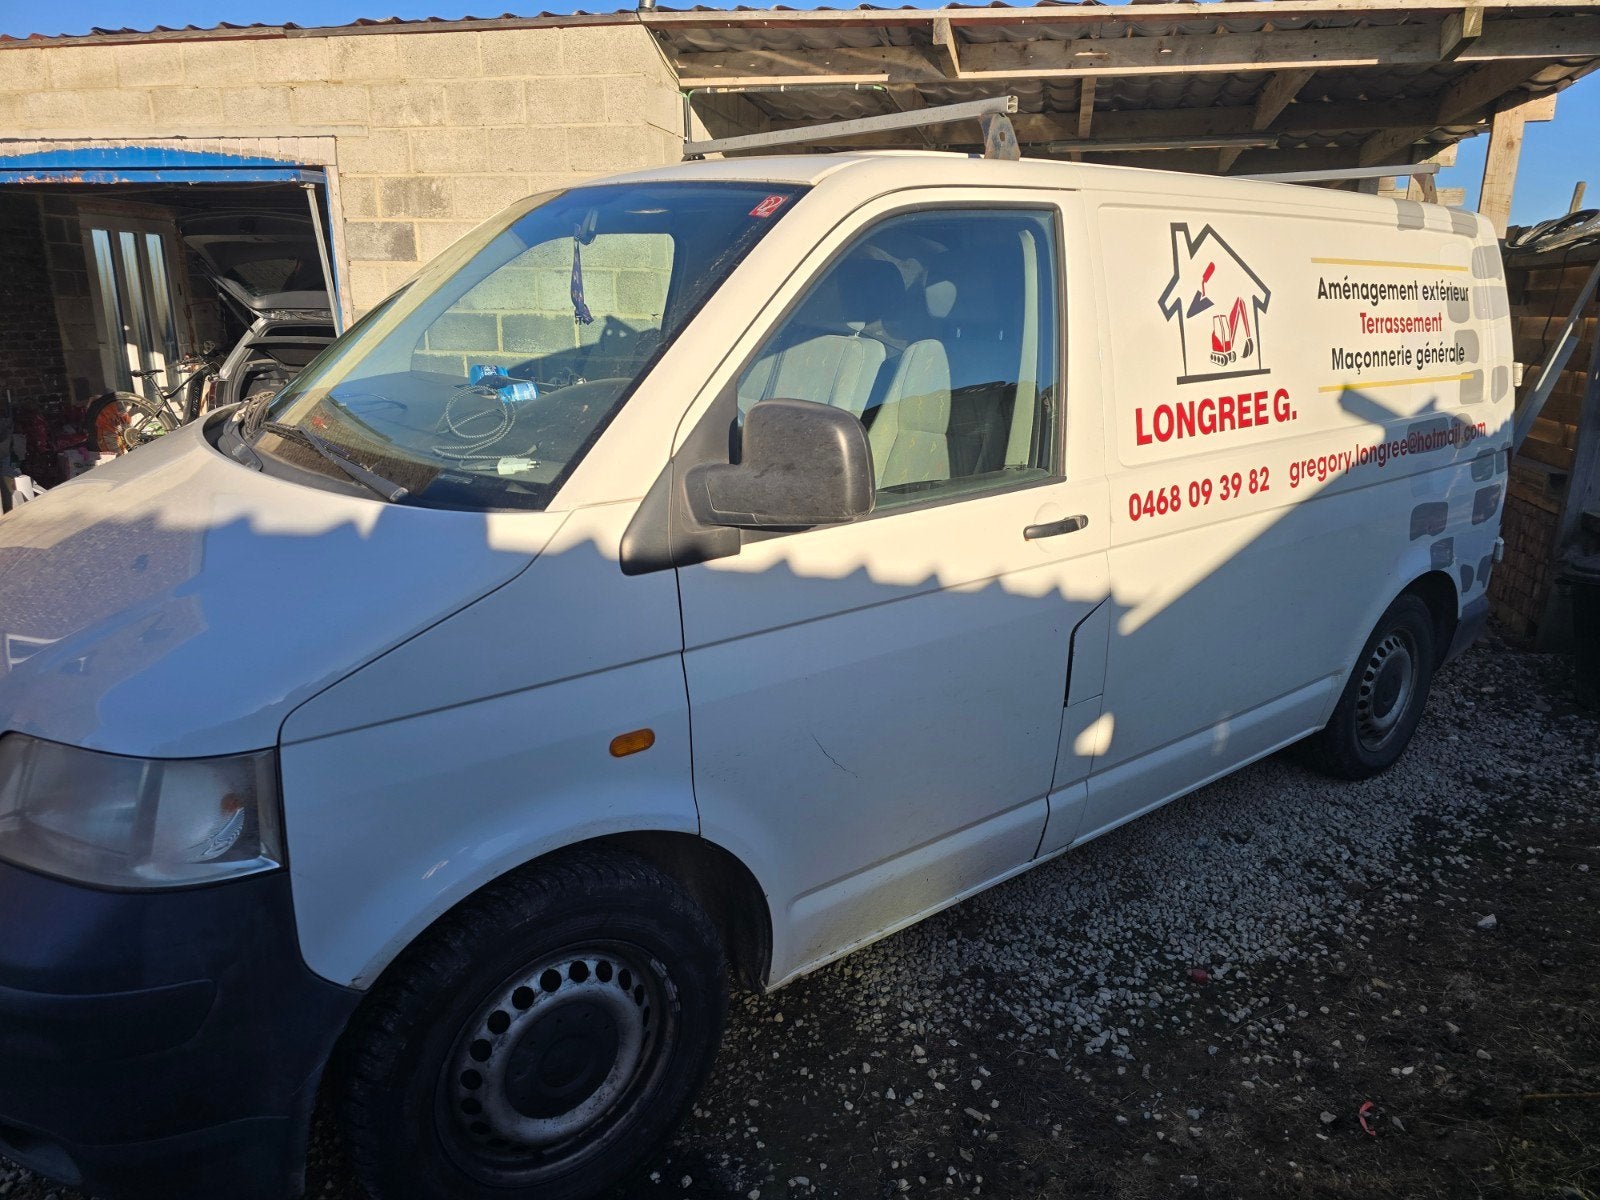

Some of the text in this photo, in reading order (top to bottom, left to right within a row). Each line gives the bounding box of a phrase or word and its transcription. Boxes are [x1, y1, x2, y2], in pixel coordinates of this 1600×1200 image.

[1317, 275, 1469, 307] Aménagement extérieur
[1359, 312, 1443, 334] Terrassement
[1331, 341, 1465, 375] Maçonnerie générale
[1135, 388, 1297, 446] LONGREE G.
[1128, 421, 1487, 521] 0468 09 39 82 gregory.longree@hotmail.com
